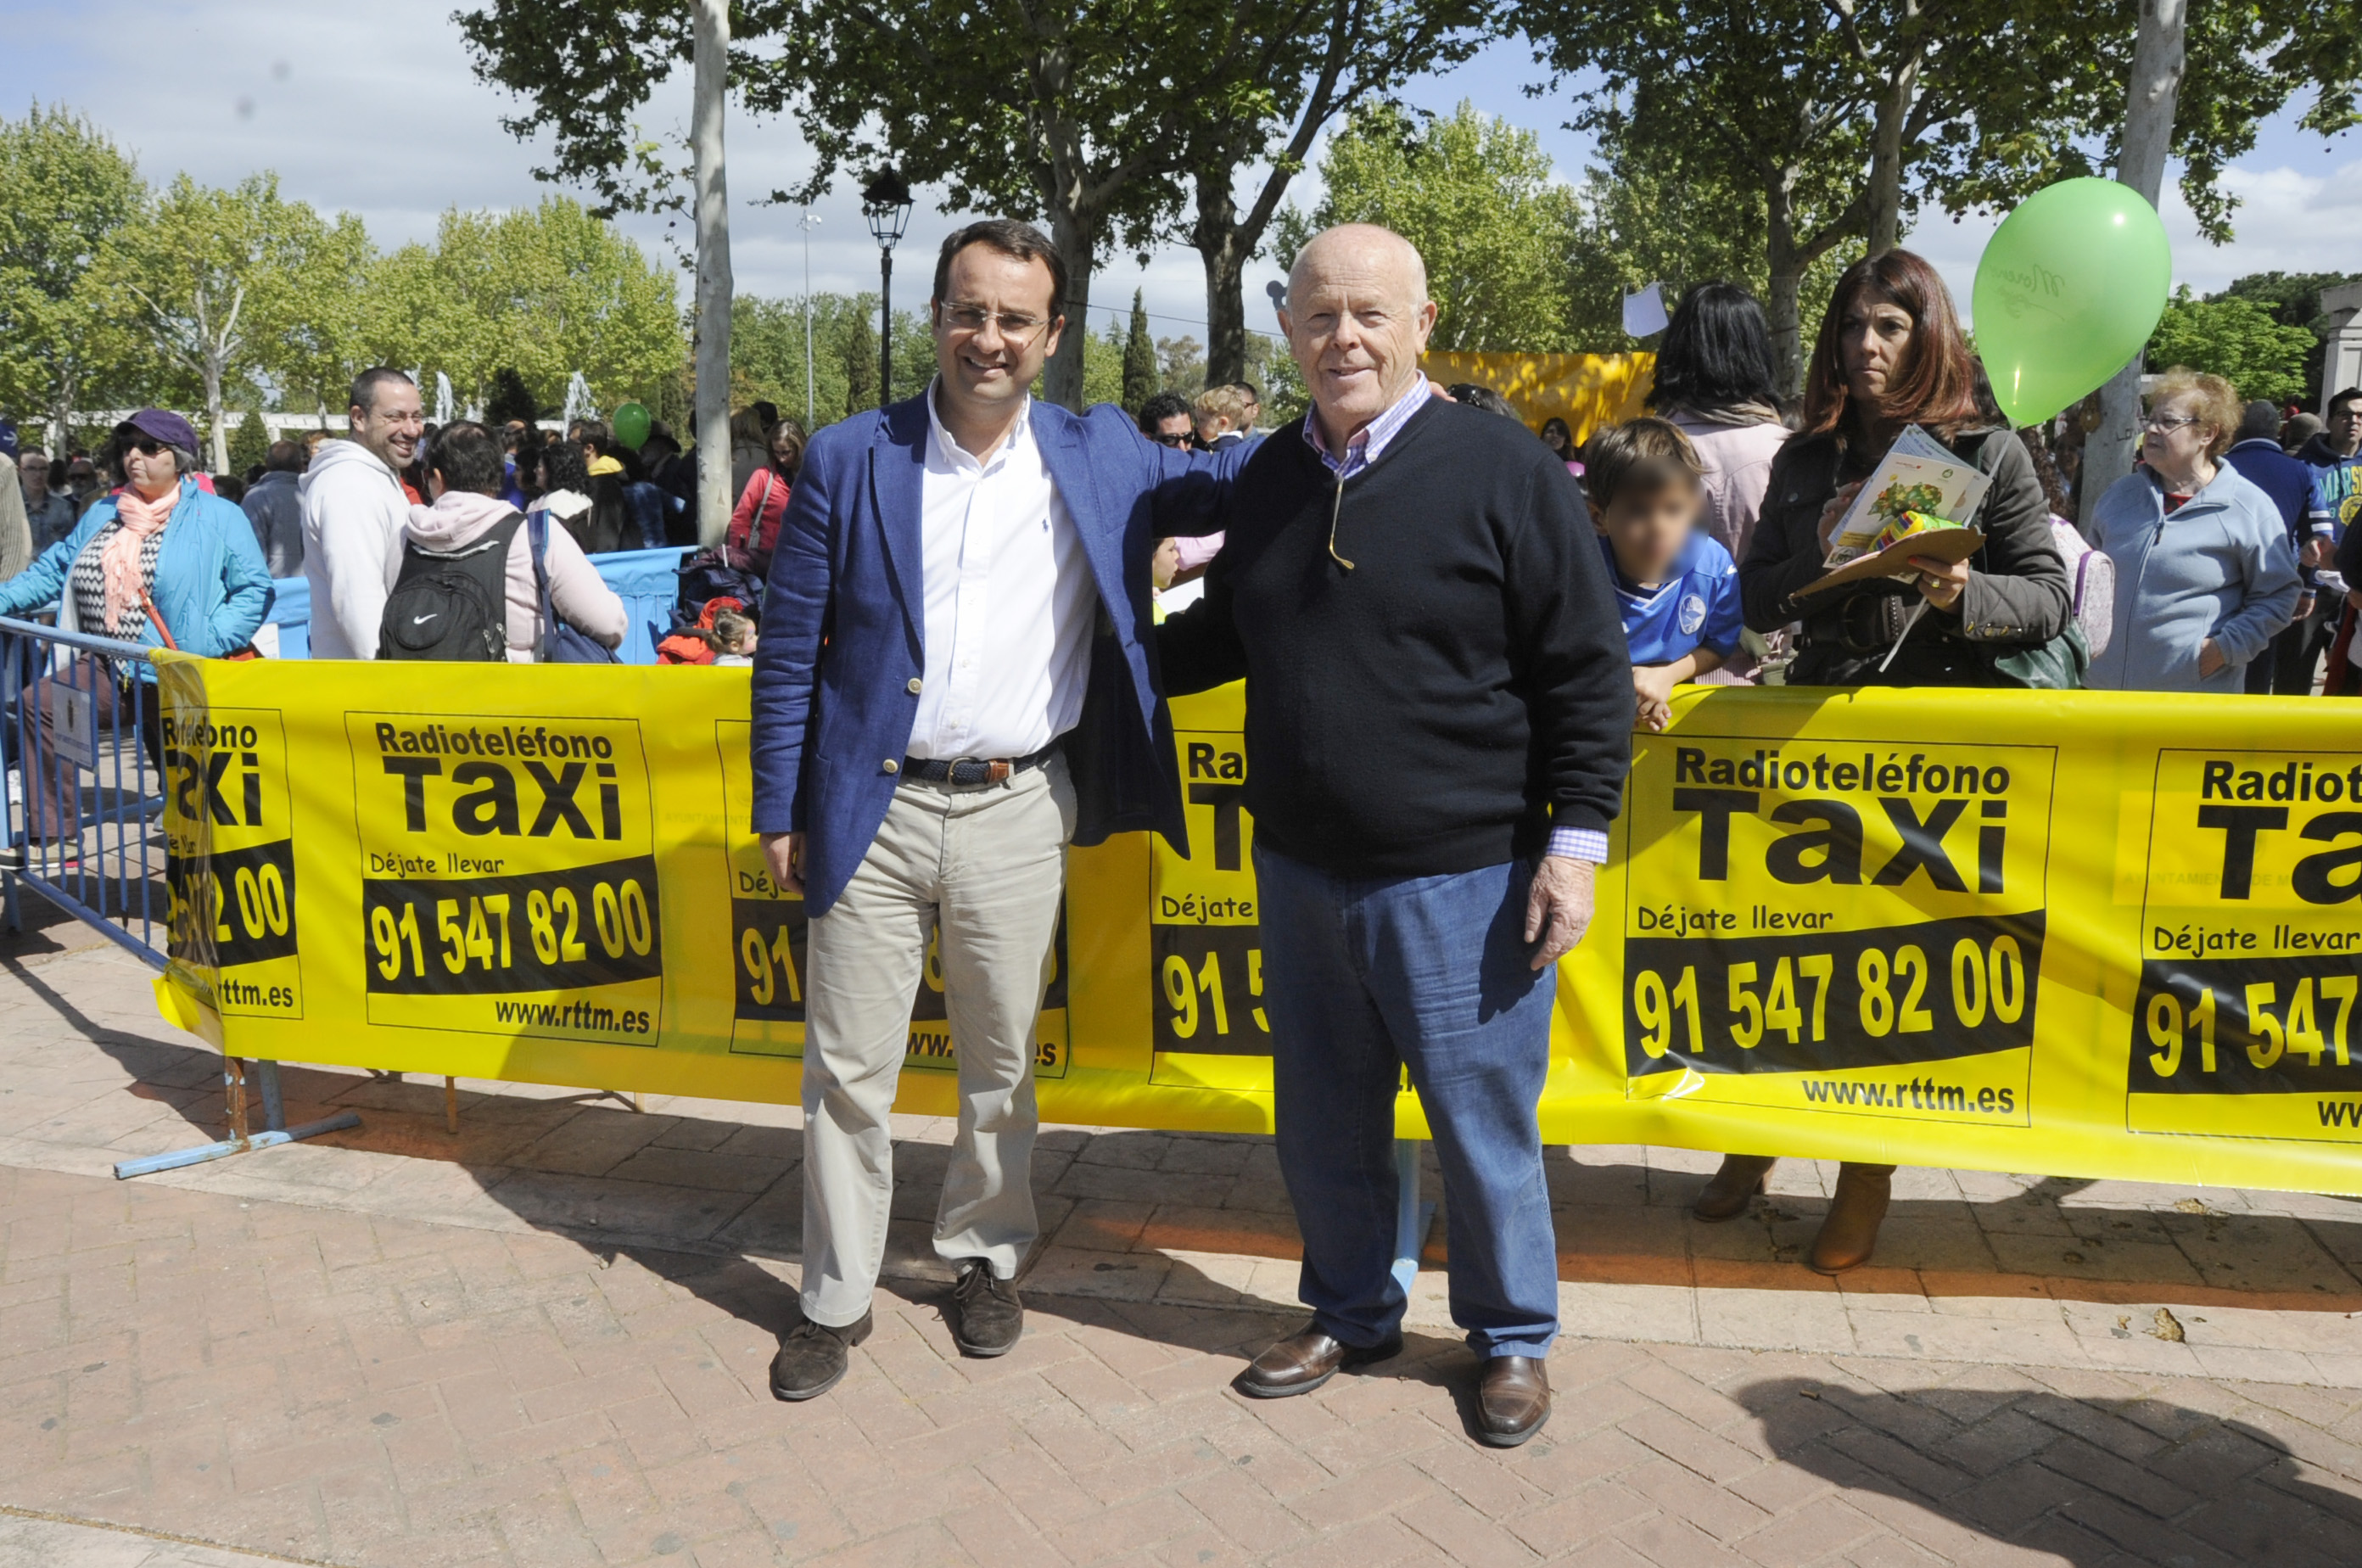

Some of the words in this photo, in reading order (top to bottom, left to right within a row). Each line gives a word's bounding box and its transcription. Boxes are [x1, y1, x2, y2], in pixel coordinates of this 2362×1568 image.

[2319, 466, 2362, 502] MARS
[375, 722, 613, 759] Radioteléfono
[1675, 747, 2010, 795] Radioteléfono
[383, 755, 622, 841] Taxi
[371, 851, 437, 879] Déjate
[447, 853, 504, 873] llevar
[1672, 789, 2007, 894] Taxi
[235, 862, 289, 940] 00
[1161, 893, 1253, 924] Déjate
[1638, 904, 1737, 938] Déjate
[1753, 904, 1833, 930] llevar
[371, 902, 426, 982] 91
[437, 893, 512, 975] 547
[527, 887, 587, 966] 82
[592, 879, 652, 959] 00
[2154, 924, 2257, 958] Déjate
[2274, 924, 2361, 949] llevar
[742, 925, 801, 1005] 91
[495, 1000, 650, 1035] www.rttm.es
[1162, 951, 1229, 1039] 91
[1634, 966, 1704, 1059] 91
[1728, 954, 1834, 1050] 547
[1857, 944, 1934, 1038] 82
[1951, 935, 2025, 1028] 00
[2147, 988, 2216, 1078] 91
[2245, 975, 2358, 1069] 547
[1801, 1075, 2015, 1115] www.rttm.es
